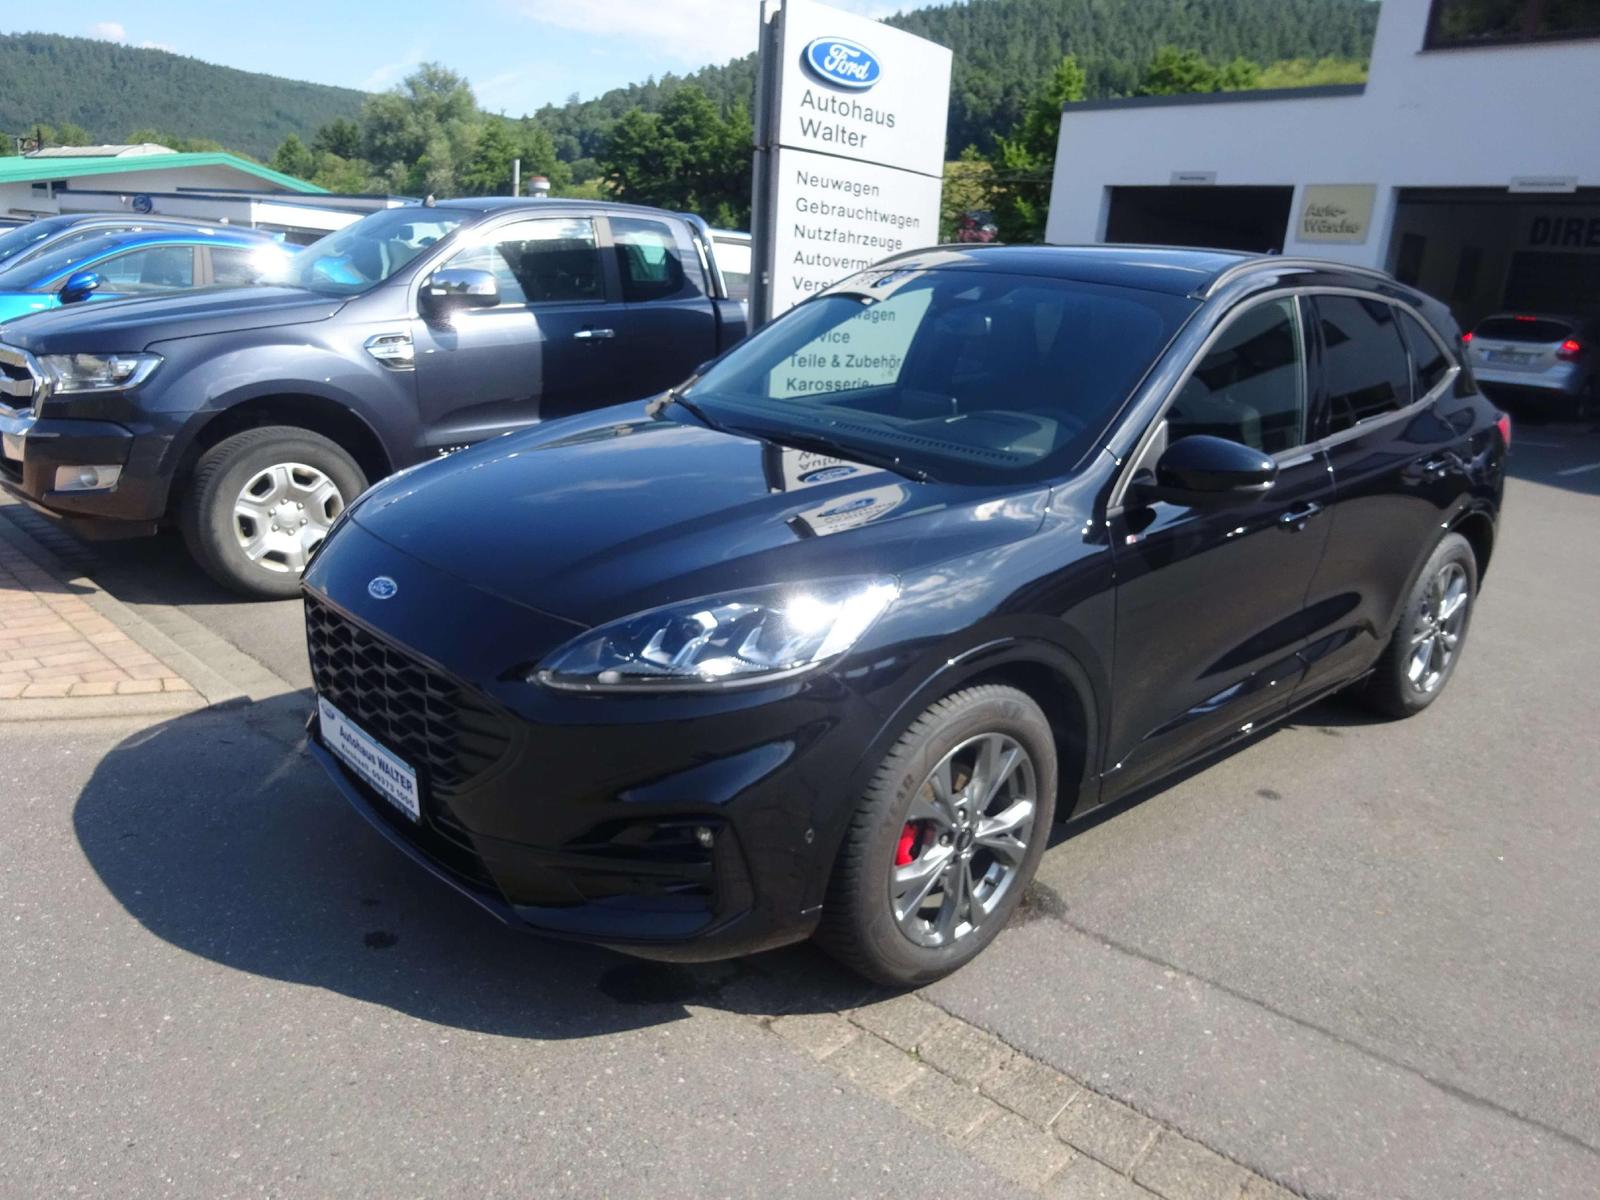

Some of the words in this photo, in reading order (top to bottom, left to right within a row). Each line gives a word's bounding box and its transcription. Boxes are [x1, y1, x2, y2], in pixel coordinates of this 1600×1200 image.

[823, 43, 871, 80] Ford
[800, 89, 896, 129] Autohaus
[799, 116, 868, 149] Walter
[796, 170, 881, 198] Neuwagen
[795, 197, 921, 230] Gebrauchtwagen
[794, 223, 903, 252] Nutzfahrzeuge
[1528, 215, 1600, 247] DIRE
[793, 250, 874, 272] Autovermi
[790, 353, 827, 368] Teile
[831, 354, 841, 368] &
[844, 354, 902, 369] Zubehör
[377, 754, 414, 795] WALTER
